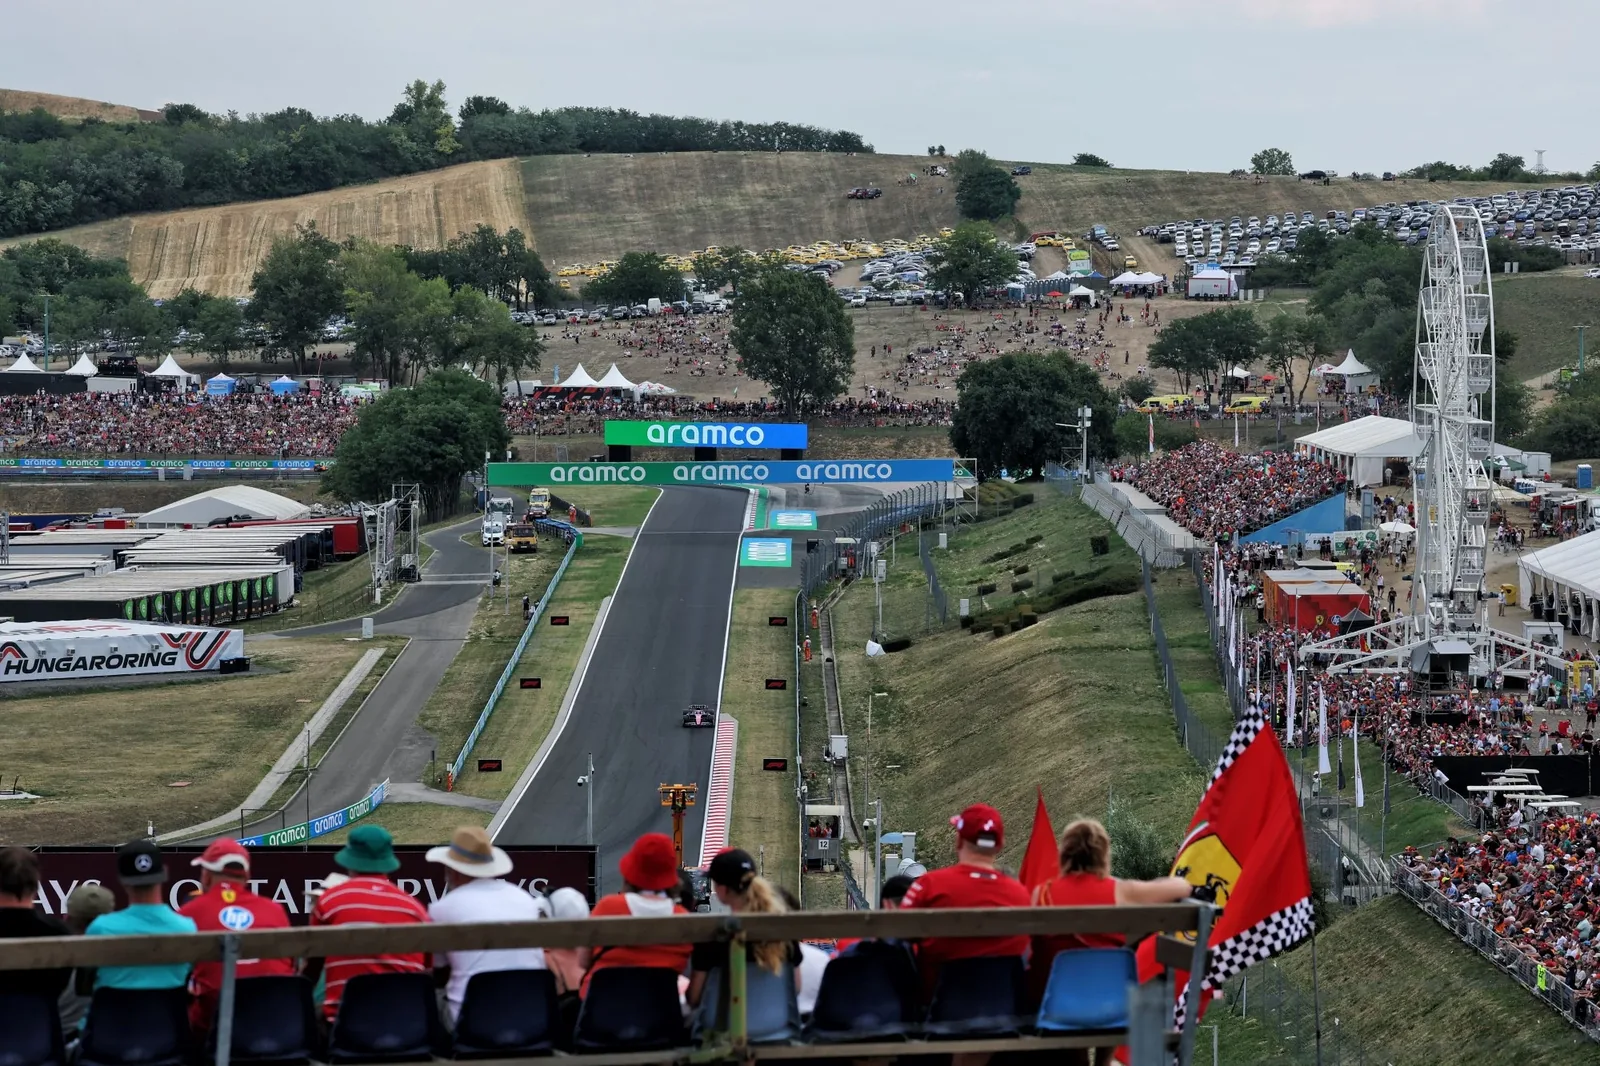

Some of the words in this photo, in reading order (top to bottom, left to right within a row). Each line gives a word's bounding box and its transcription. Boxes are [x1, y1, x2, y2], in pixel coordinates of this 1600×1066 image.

[646, 424, 764, 446] aramco
[66, 459, 99, 467] aramco
[192, 460, 226, 468] aramco
[234, 460, 268, 468] aramco
[277, 460, 310, 468] aramco
[796, 463, 892, 479] aramco
[550, 465, 646, 482] aramco
[673, 465, 769, 481] aramco
[4, 651, 178, 675] HUNGARORING
[350, 800, 370, 820] aramco
[314, 813, 343, 833] aramco
[269, 826, 306, 846] aramco
[222, 906, 251, 930] hp
